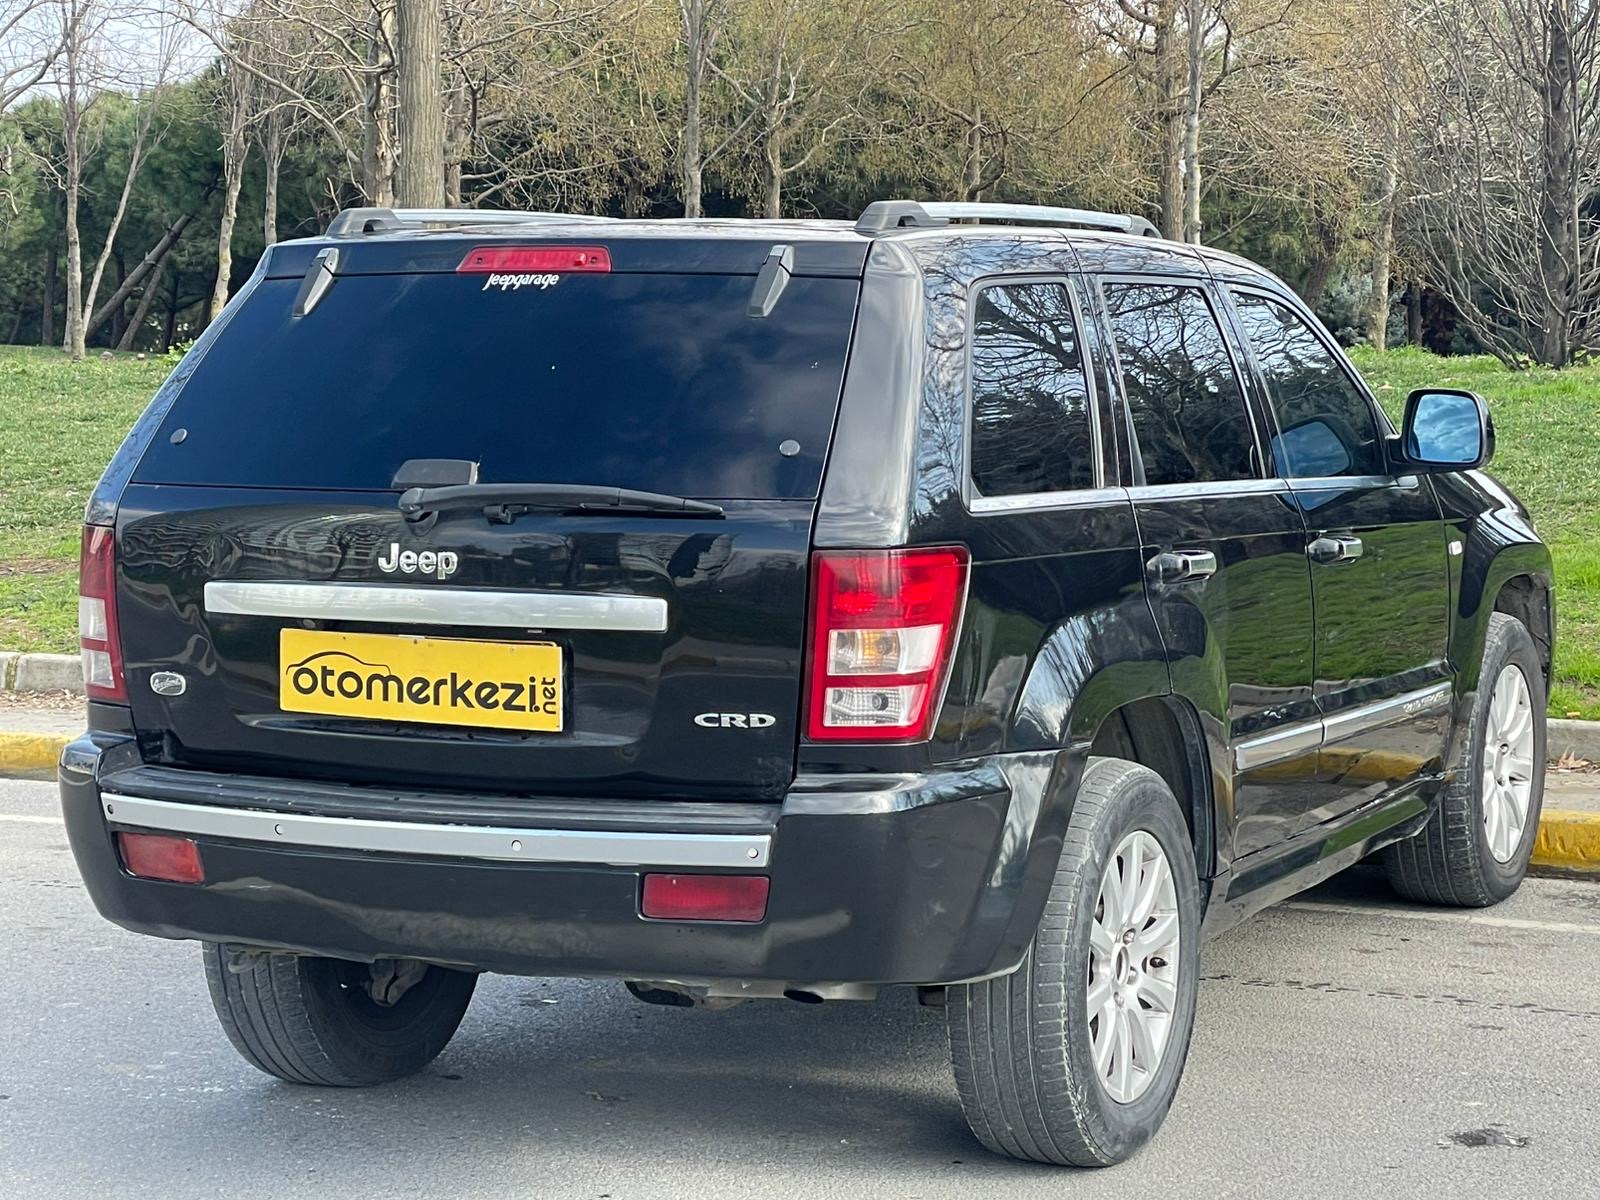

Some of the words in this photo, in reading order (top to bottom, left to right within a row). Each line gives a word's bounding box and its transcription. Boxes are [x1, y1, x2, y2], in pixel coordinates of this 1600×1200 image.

[481, 273, 560, 291] Jeepgarage
[378, 542, 458, 580] Jeep
[694, 712, 776, 729] CRD
